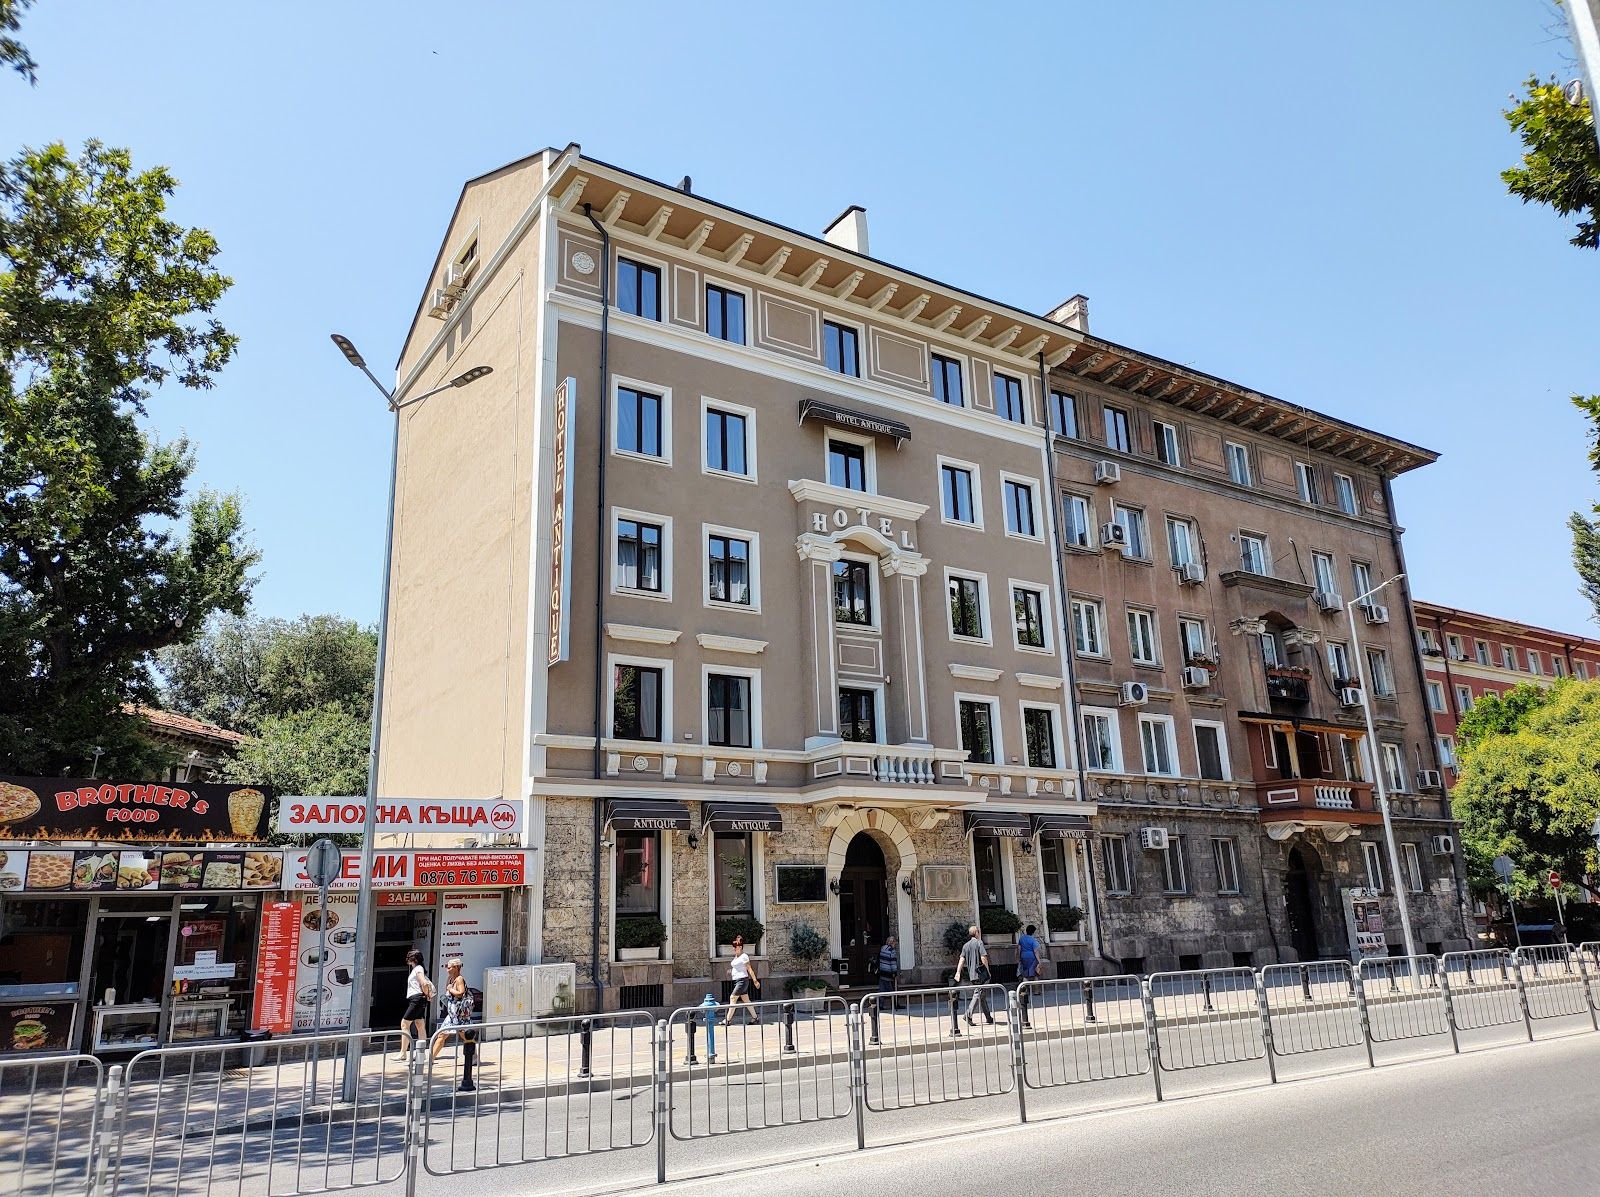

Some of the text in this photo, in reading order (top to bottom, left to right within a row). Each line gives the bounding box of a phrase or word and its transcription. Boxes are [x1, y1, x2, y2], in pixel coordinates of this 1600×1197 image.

[835, 412, 893, 434] HOTEL ANTIQUE
[551, 388, 565, 657] HOTEL ANTIQUE
[812, 508, 915, 550] HOTEL
[106, 808, 160, 822] FOOD
[419, 805, 489, 828] КЪЩА
[493, 811, 514, 822] 24h
[633, 819, 677, 829] ANTIQUE
[731, 821, 771, 831] ANTIQUE
[993, 827, 1023, 837] ANTIQUE
[1059, 830, 1088, 839] ANTIQUE
[296, 855, 408, 880] ЗЕМИ
[420, 869, 520, 885] 0876 76 76 76
[387, 892, 428, 902] ЗАЕМИ
